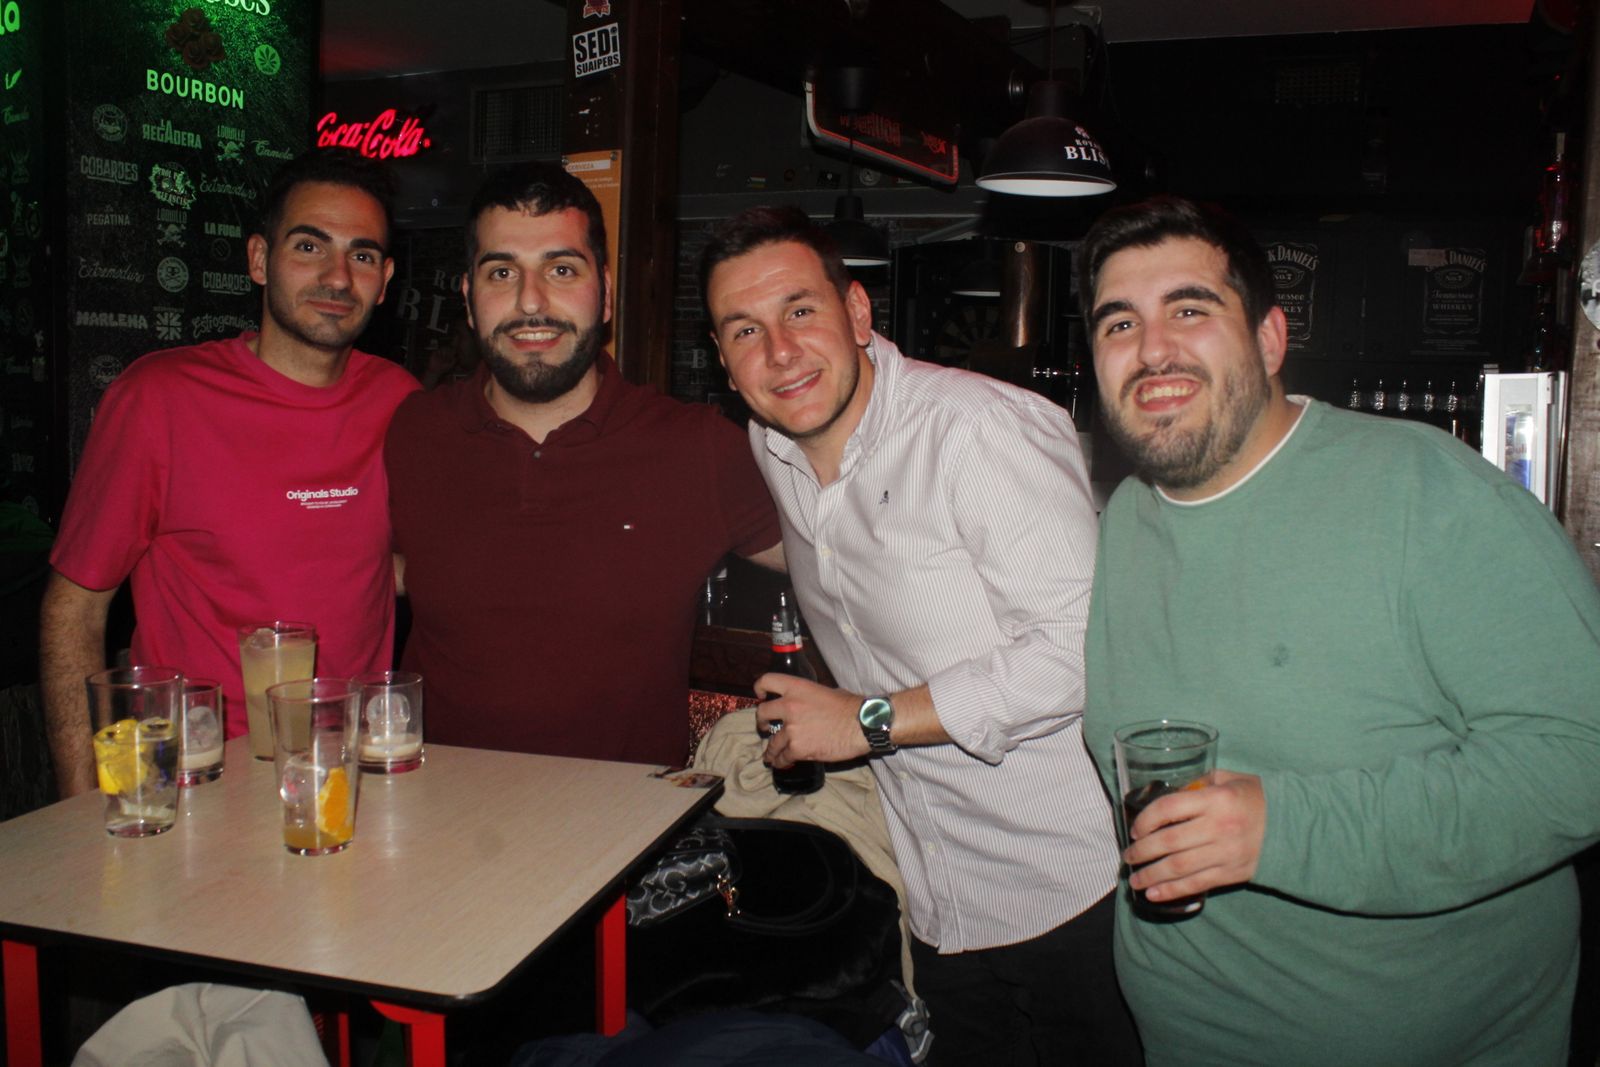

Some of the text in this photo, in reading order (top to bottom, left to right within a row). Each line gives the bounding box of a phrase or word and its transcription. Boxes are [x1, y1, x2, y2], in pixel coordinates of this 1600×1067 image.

[146, 68, 245, 110] BOURBON
[317, 109, 425, 159] Coca-Cola
[80, 155, 139, 183] COBARDES
[86, 213, 130, 226] PEGATINA
[204, 222, 216, 235] LA
[203, 271, 252, 293] COBARDES
[286, 487, 359, 502] Originals Studio
